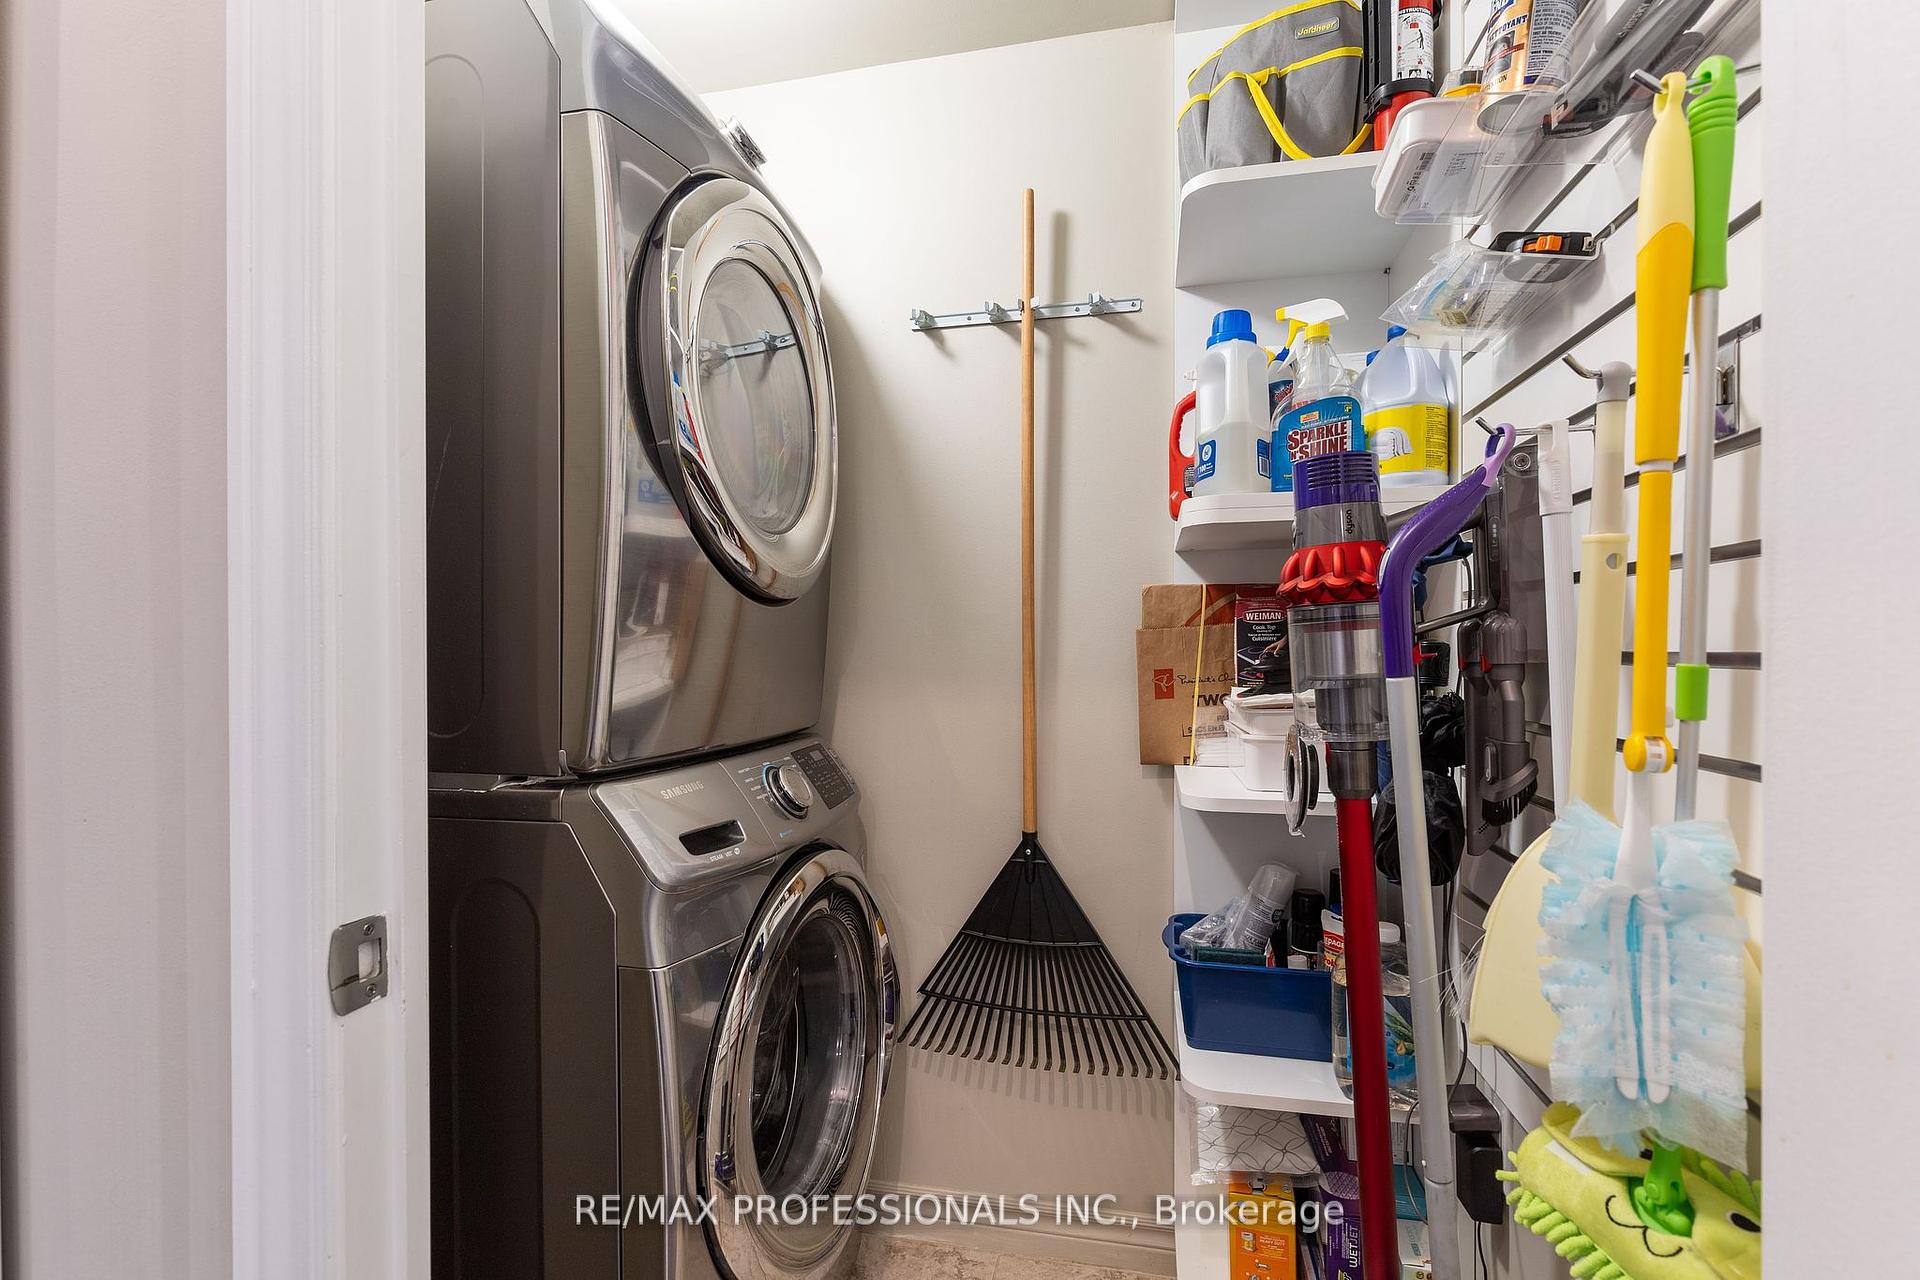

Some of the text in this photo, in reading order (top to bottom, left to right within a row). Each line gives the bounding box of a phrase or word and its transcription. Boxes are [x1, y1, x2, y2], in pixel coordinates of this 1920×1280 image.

[1287, 421, 1347, 451] SPARKLE
[1299, 435, 1347, 461] SHINE
[1345, 509, 1356, 535] dyson
[1245, 612, 1281, 621] WEIMAN
[1187, 725, 1206, 734] SCS
[660, 780, 704, 800] SAMSUNG
[1349, 1224, 1359, 1268] WETJET
